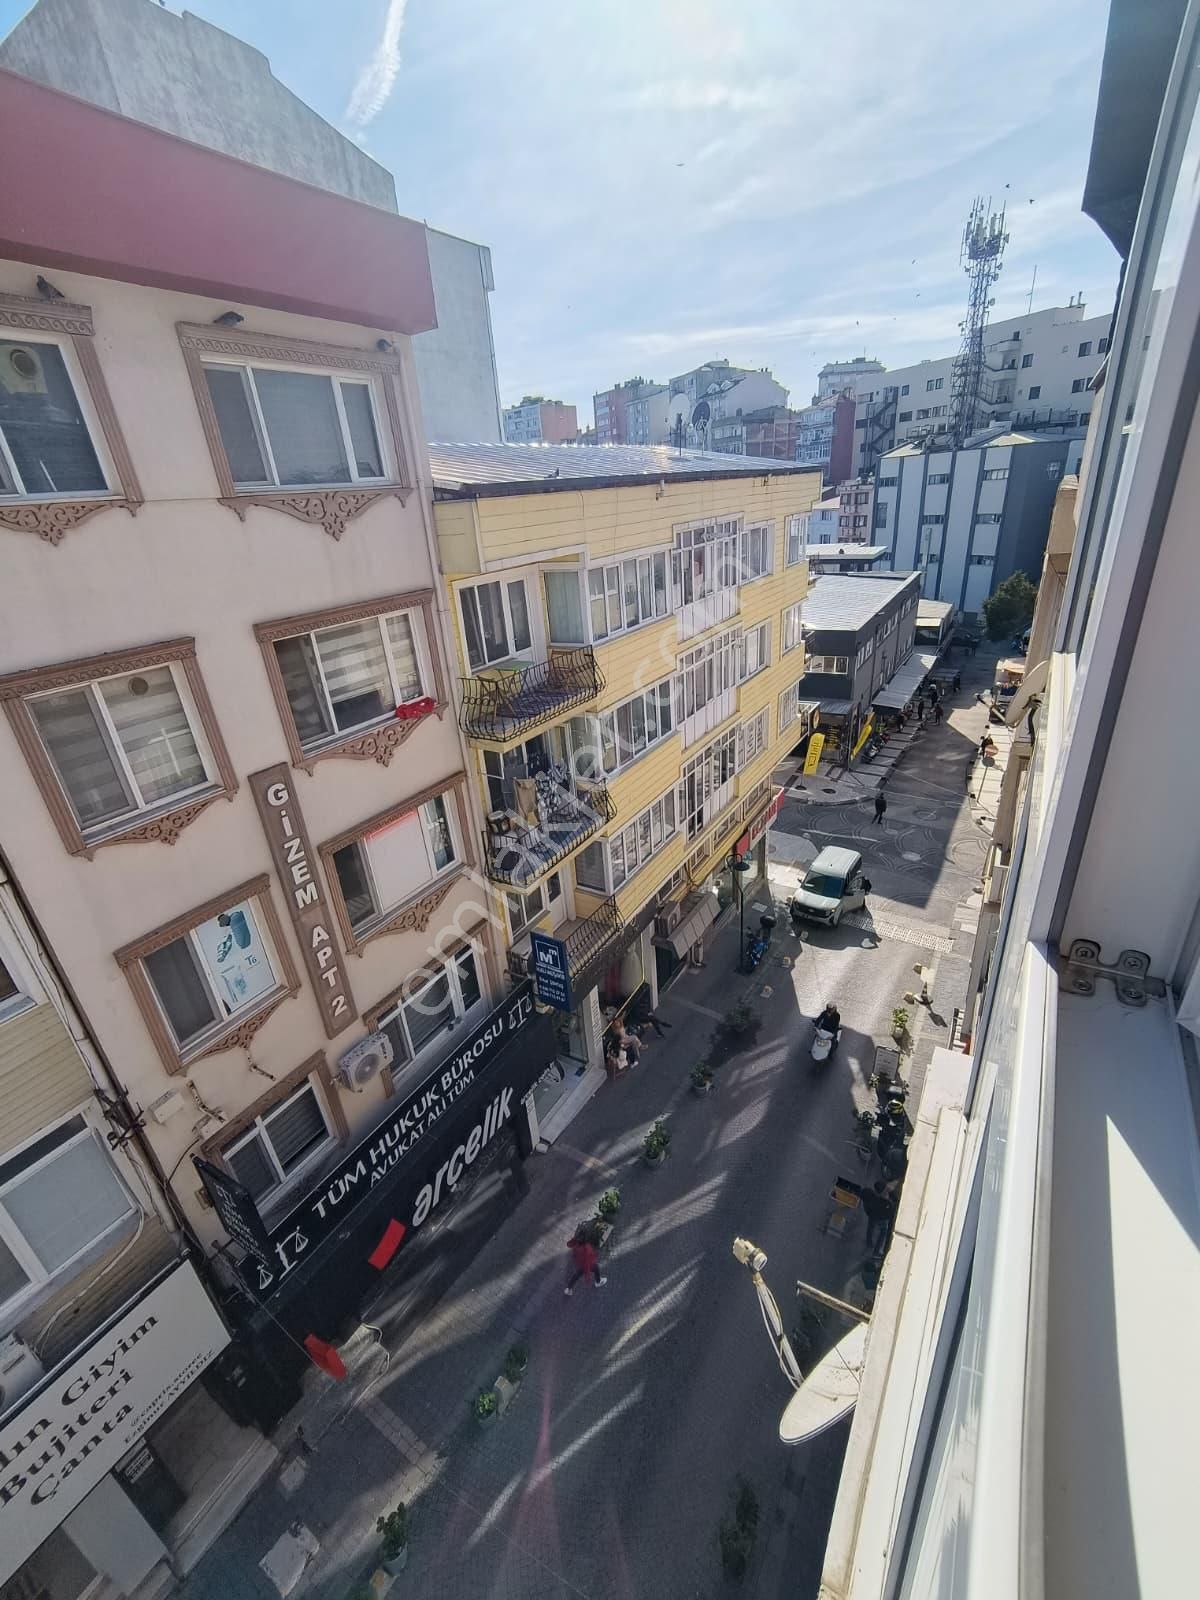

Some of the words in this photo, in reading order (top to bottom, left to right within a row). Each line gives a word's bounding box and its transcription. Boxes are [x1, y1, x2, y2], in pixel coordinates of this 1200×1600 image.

[311, 925, 337, 988] APT
[331, 994, 347, 1017] 2
[311, 1159, 367, 1218] TÜM
[368, 1083, 440, 1165] HUKUK
[440, 1018, 504, 1092] BÜROSU
[369, 1124, 425, 1188] AVUKAT
[446, 1069, 475, 1104] TÜM
[412, 1086, 513, 1228] arçelik
[61, 1315, 159, 1406] Giyim
[0, 1368, 134, 1507] Bujiteri
[30, 1403, 134, 1506] Çanta
